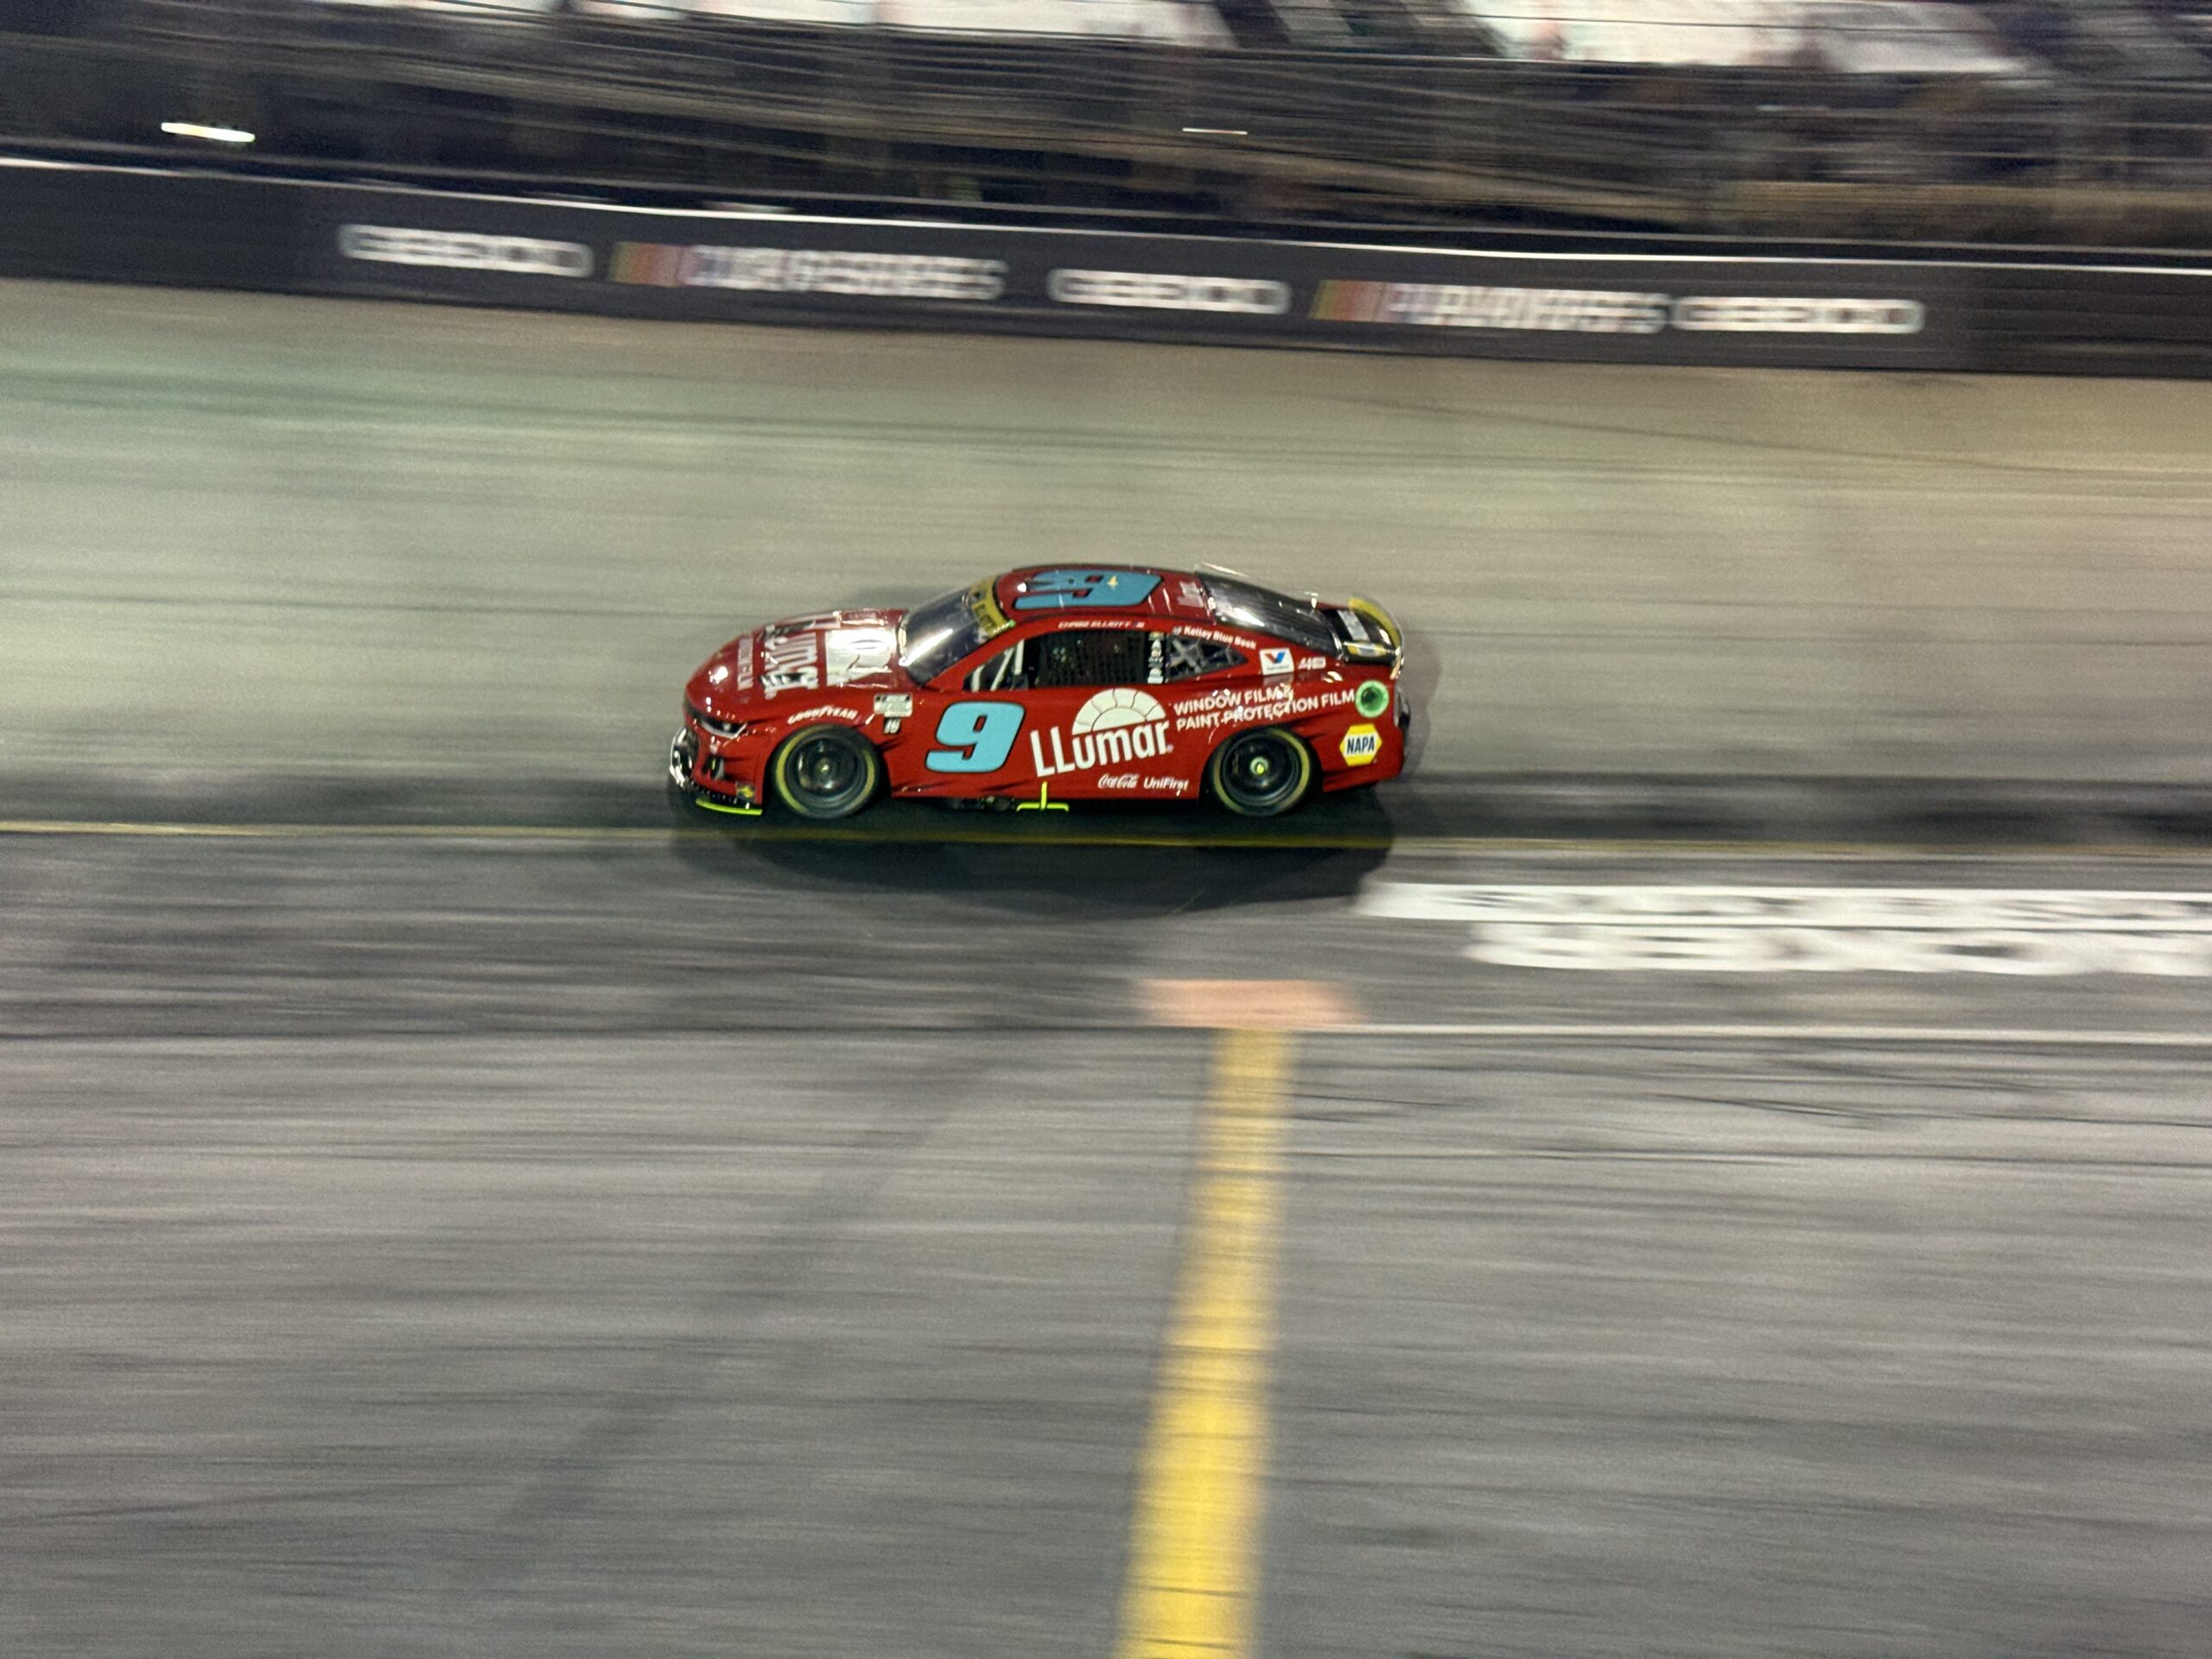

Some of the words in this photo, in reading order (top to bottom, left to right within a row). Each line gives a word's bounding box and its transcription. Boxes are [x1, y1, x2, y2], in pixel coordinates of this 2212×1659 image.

[1184, 626, 1212, 639] Kelley
[1212, 631, 1234, 644] Blue
[1234, 636, 1256, 650] Book
[1173, 691, 1242, 716] WINDOW
[1176, 711, 1221, 732] PAINT
[1320, 688, 1355, 708] FILM
[924, 700, 1027, 774] 9
[1030, 720, 1170, 778] LLumar
[1346, 736, 1376, 754] NAPA
